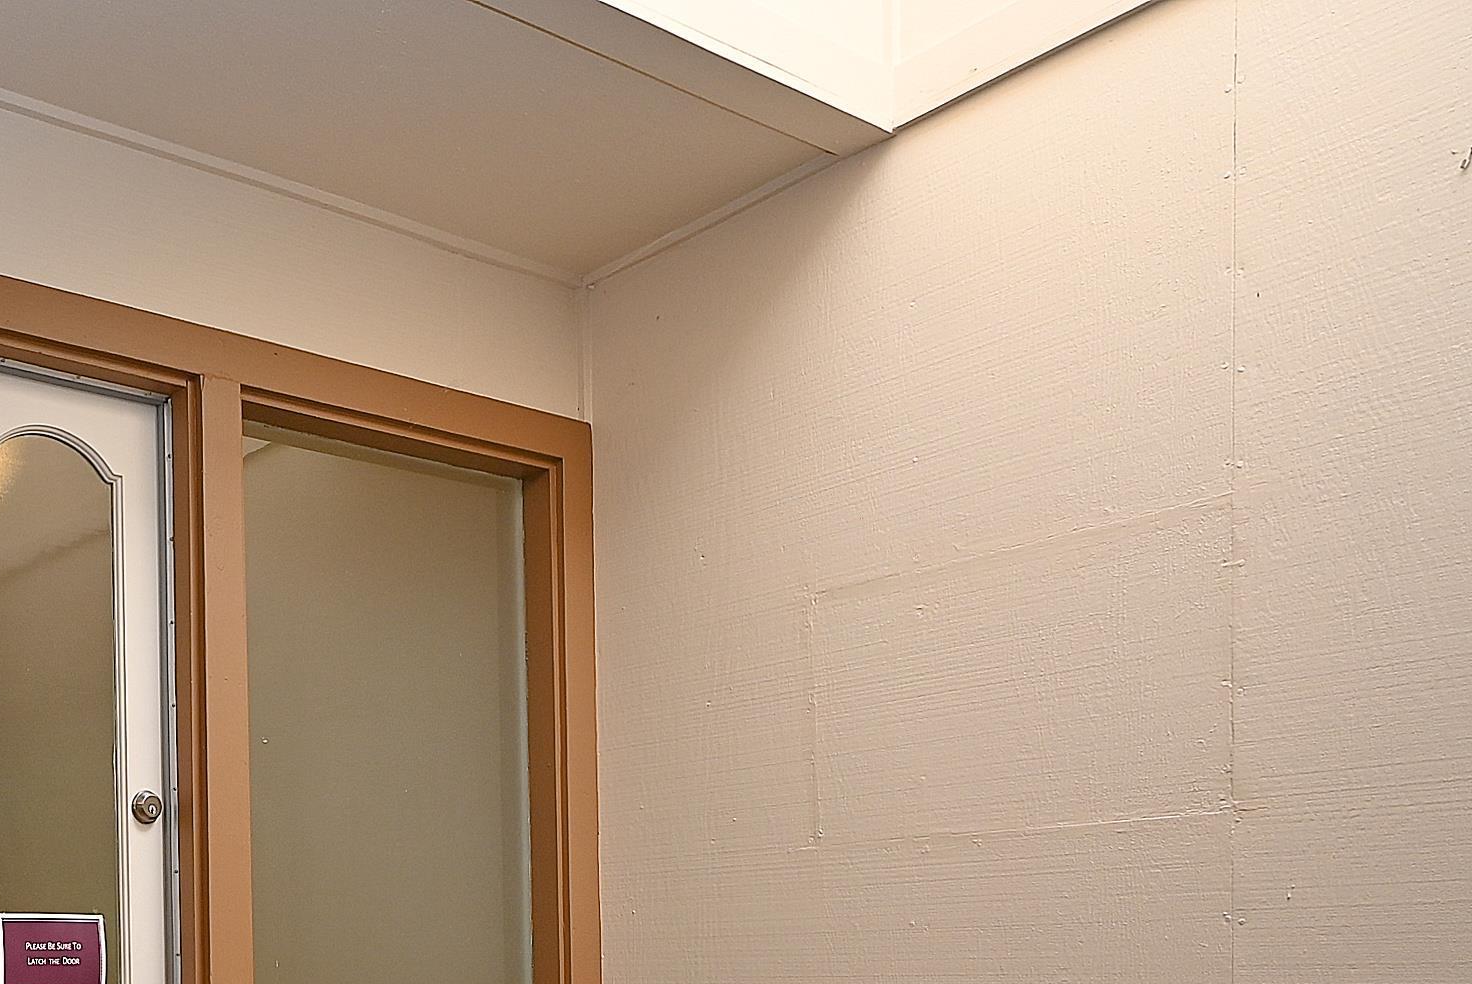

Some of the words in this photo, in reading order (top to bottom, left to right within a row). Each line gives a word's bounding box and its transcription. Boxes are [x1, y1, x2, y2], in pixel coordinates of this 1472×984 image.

[25, 941, 47, 951] PLEASE
[47, 941, 56, 951] BE
[72, 941, 82, 951] TO
[27, 957, 47, 966] LATCH
[48, 957, 61, 965] THE
